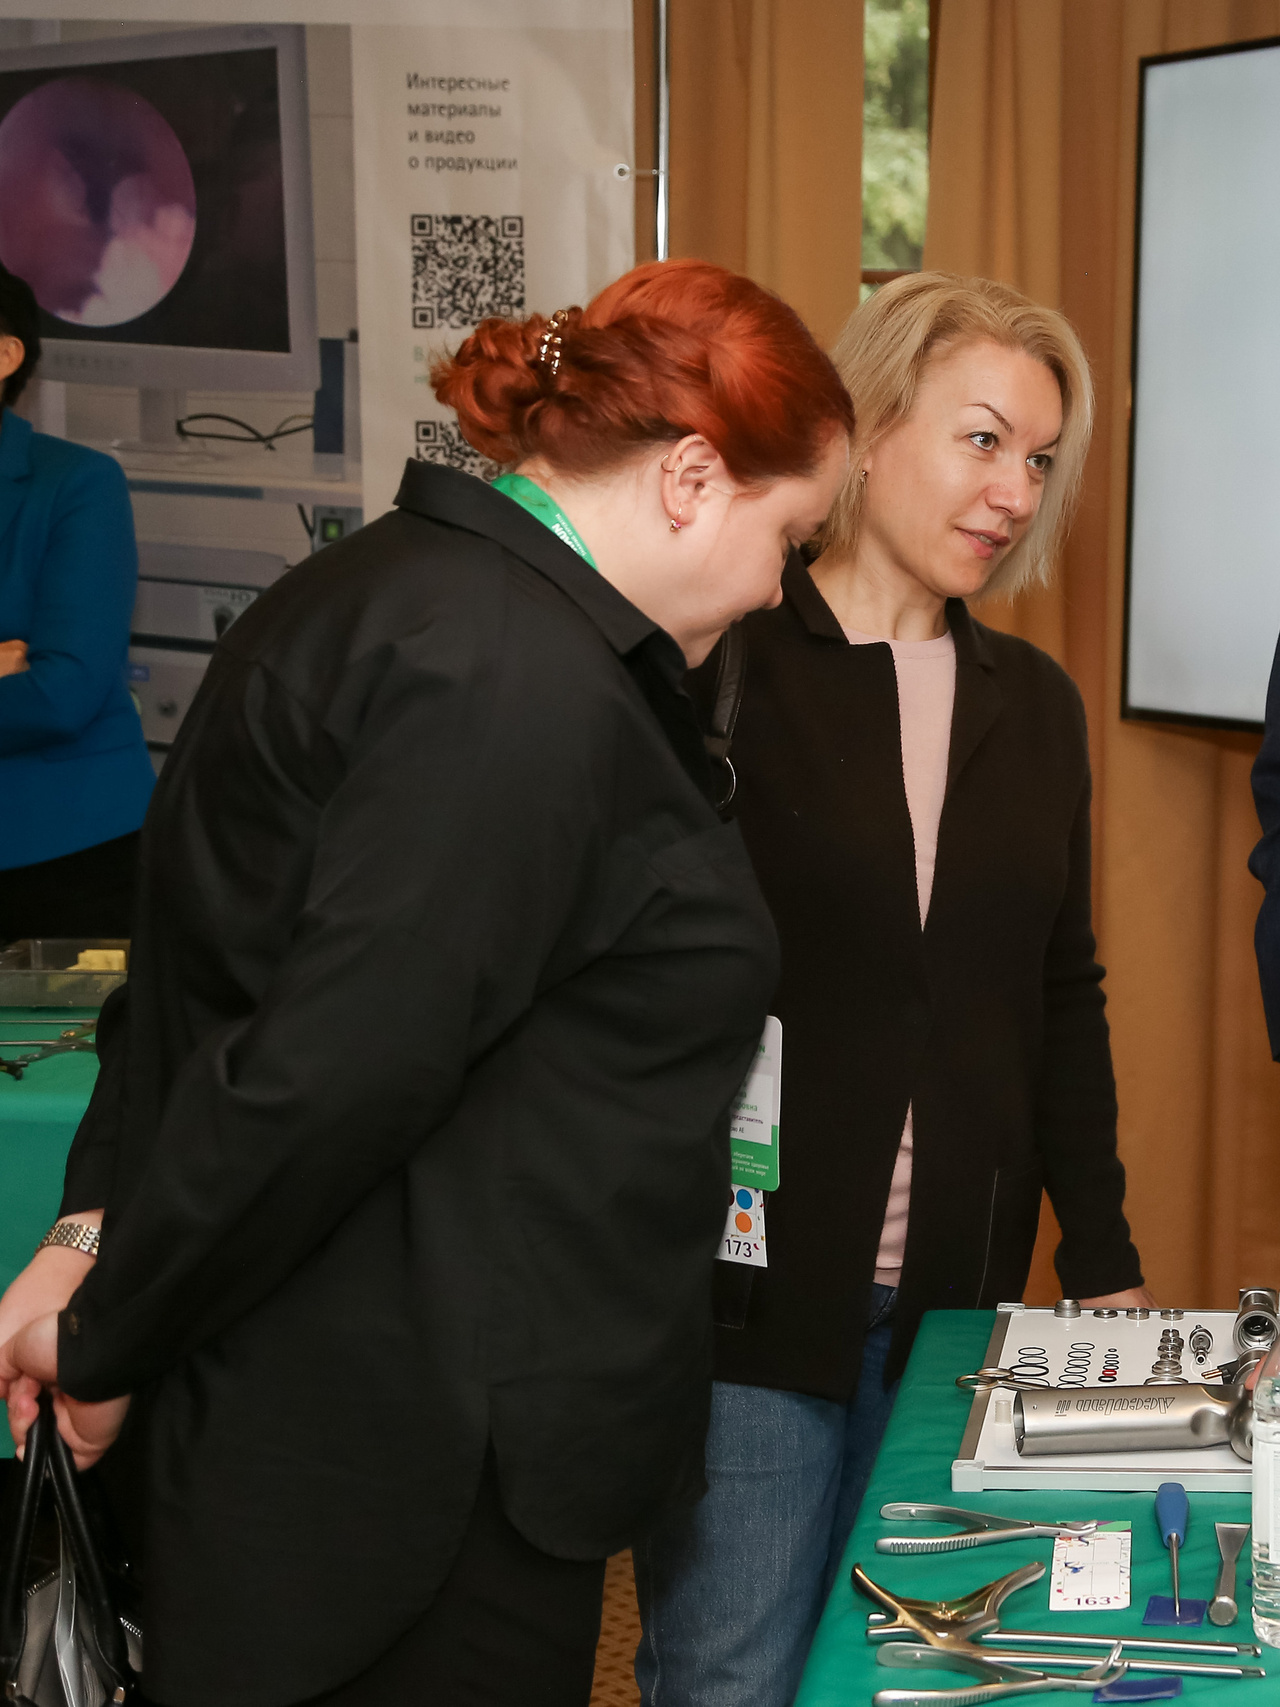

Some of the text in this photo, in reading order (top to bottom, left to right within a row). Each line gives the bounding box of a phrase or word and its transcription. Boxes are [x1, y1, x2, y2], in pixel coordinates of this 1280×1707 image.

[406, 72, 511, 93] Интересные
[407, 103, 501, 120] материалы
[408, 130, 476, 145] и видео
[408, 156, 517, 173] о продукции
[724, 1238, 753, 1258] 173
[1074, 1596, 1111, 1606] 163
